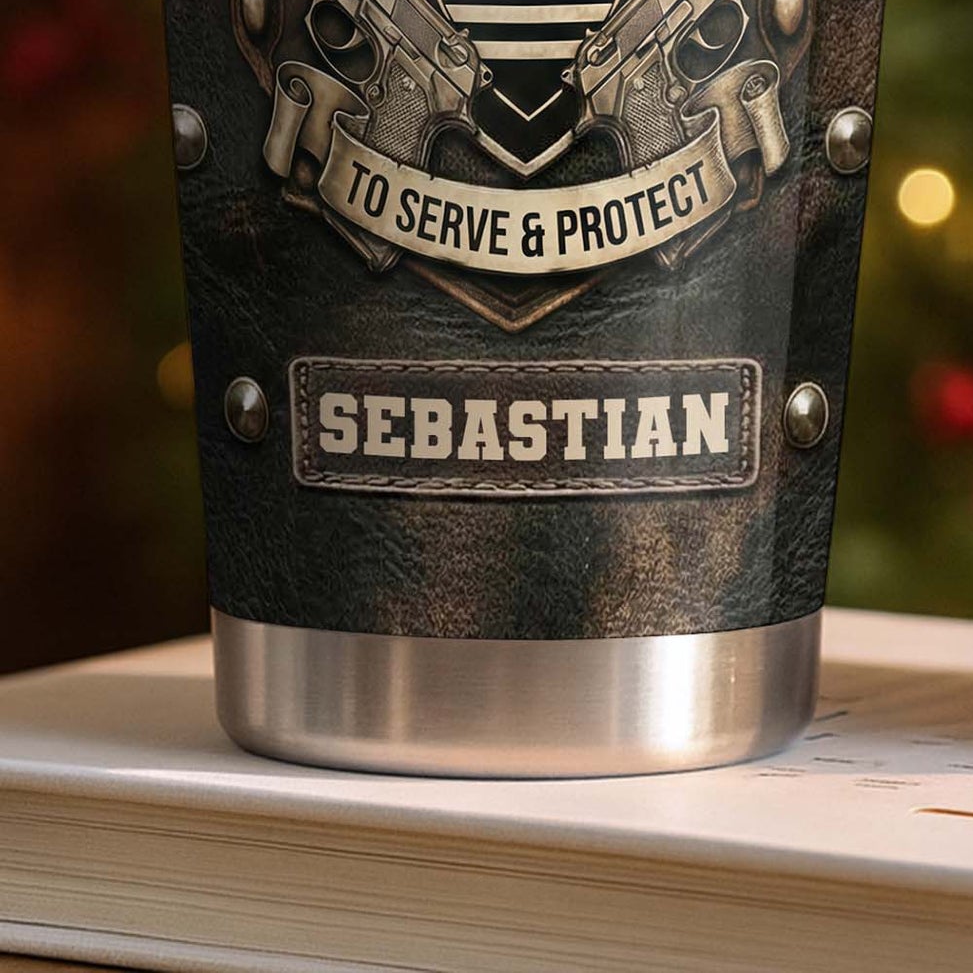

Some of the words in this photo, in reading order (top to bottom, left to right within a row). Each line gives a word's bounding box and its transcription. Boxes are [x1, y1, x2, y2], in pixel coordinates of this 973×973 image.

[347, 161, 389, 218] TO
[396, 188, 509, 256] SERVE
[521, 213, 544, 257] &
[557, 160, 710, 255] PROTECT
[319, 392, 729, 461] SEBASTIAN
